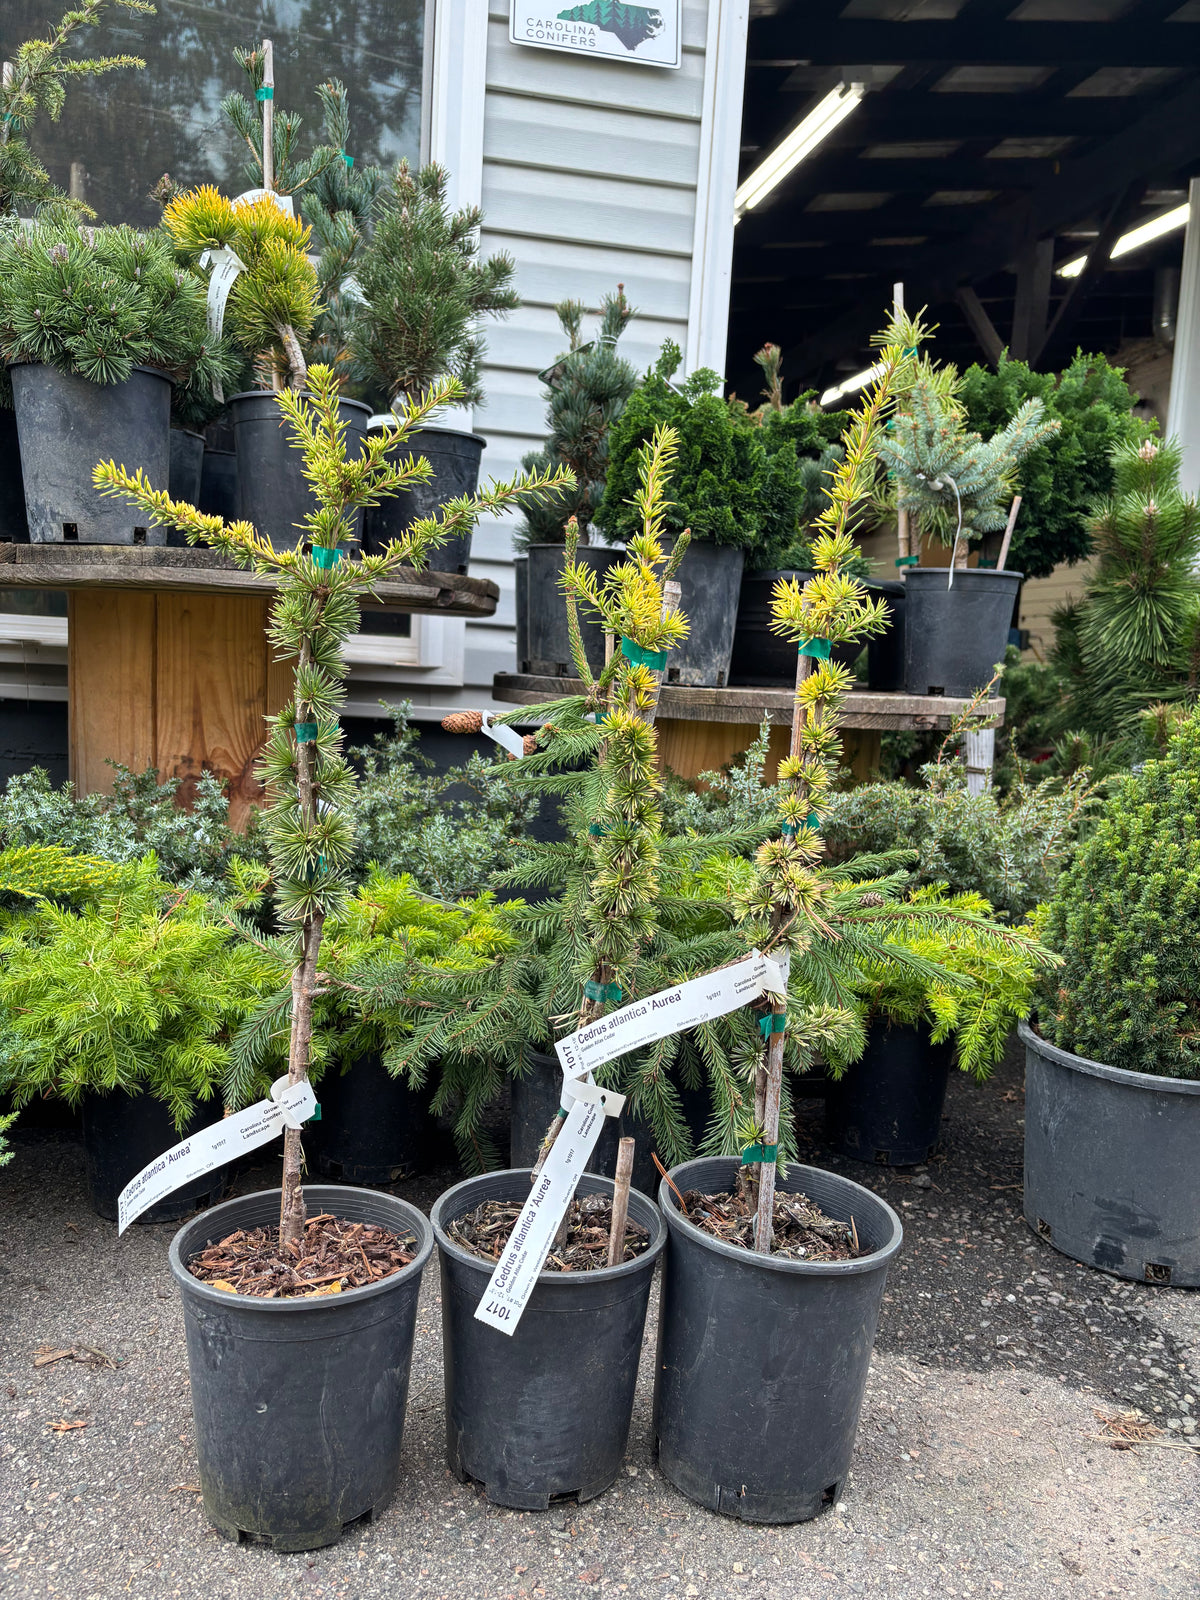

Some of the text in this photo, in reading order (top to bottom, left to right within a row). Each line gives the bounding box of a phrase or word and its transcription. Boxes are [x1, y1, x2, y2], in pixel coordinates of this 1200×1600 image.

[526, 17, 596, 36] CAROLINA
[526, 28, 596, 47] CONIFERS
[577, 989, 682, 1045] Cedrus atlantica 'Aurea'
[562, 1045, 577, 1070] 1017
[239, 1120, 262, 1134] Carolina
[286, 1100, 303, 1111] ursery
[582, 1112, 597, 1138] Landscape
[242, 1124, 270, 1140] Landscape
[125, 1179, 141, 1199] Cedrus
[141, 1160, 166, 1184] atlantica
[165, 1142, 192, 1165] 'Aurea'
[494, 1174, 552, 1288] Cedrus atlantica 'Aurea'
[485, 1300, 511, 1321] 1017
